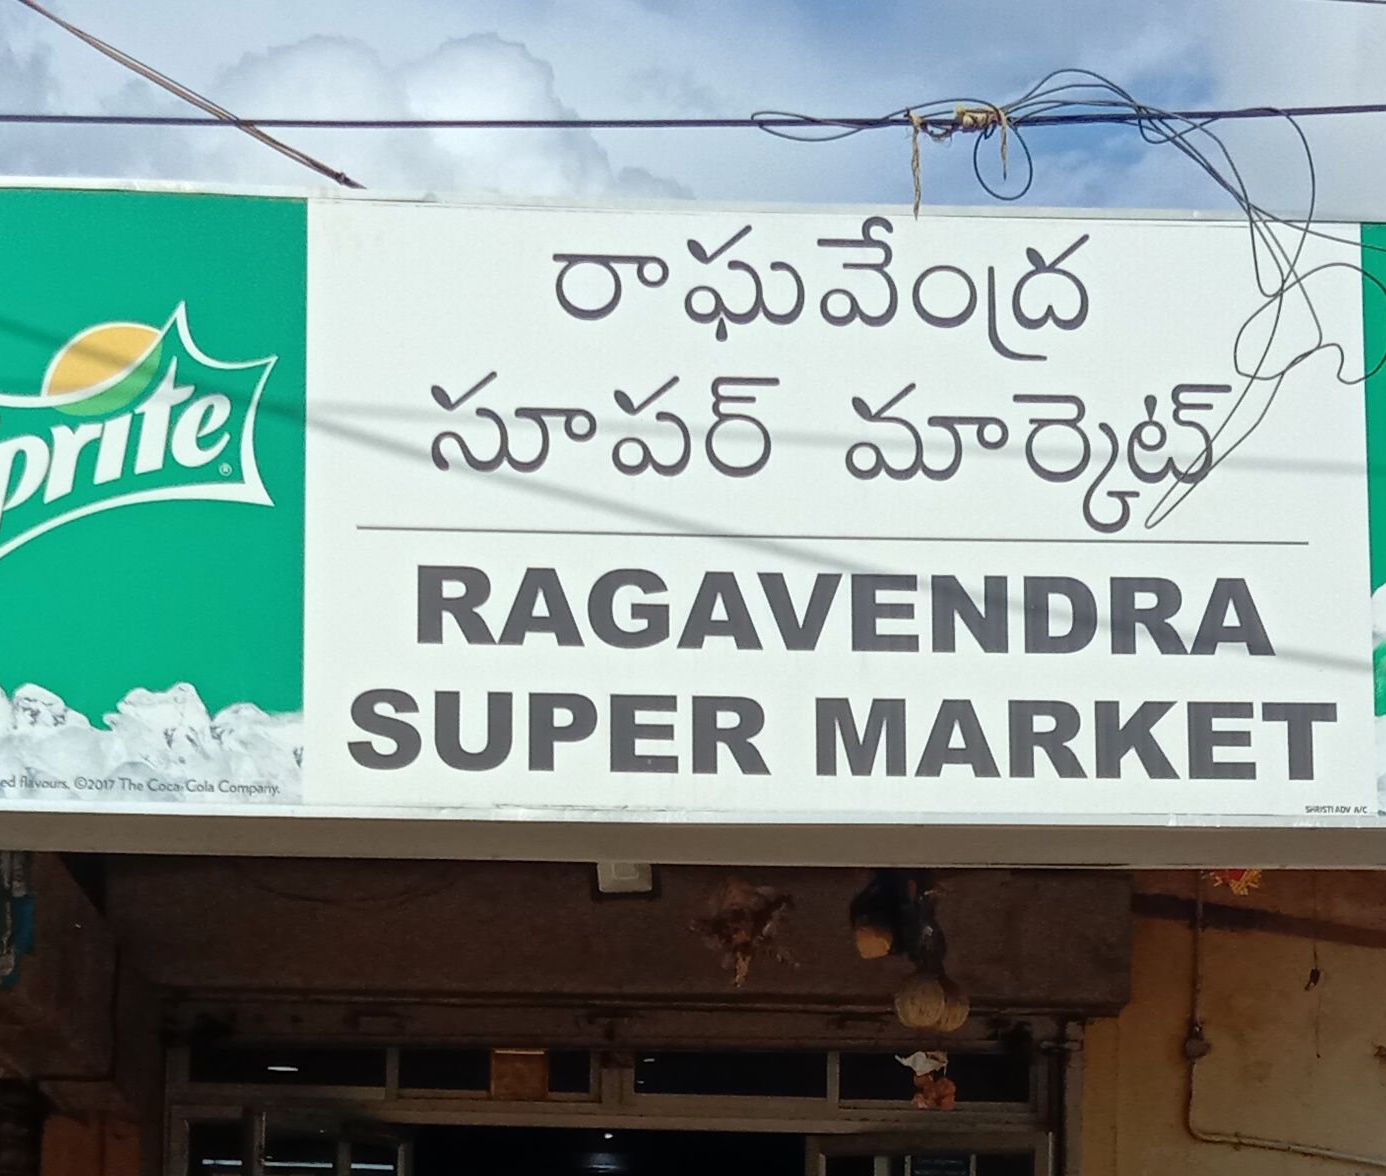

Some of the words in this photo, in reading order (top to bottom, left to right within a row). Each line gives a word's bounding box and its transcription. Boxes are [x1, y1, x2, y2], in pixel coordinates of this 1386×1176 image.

[430, 371, 780, 478] సూపర్
[846, 382, 1234, 534] మార్కెట్
[416, 564, 1275, 657] RAGAVENDRA
[347, 688, 771, 777] SUPER
[813, 695, 1338, 784] MARKET
[74, 776, 115, 791] ©2017
[118, 777, 144, 791] The
[147, 778, 215, 793] Coca-Cola
[218, 779, 280, 796] Company.
